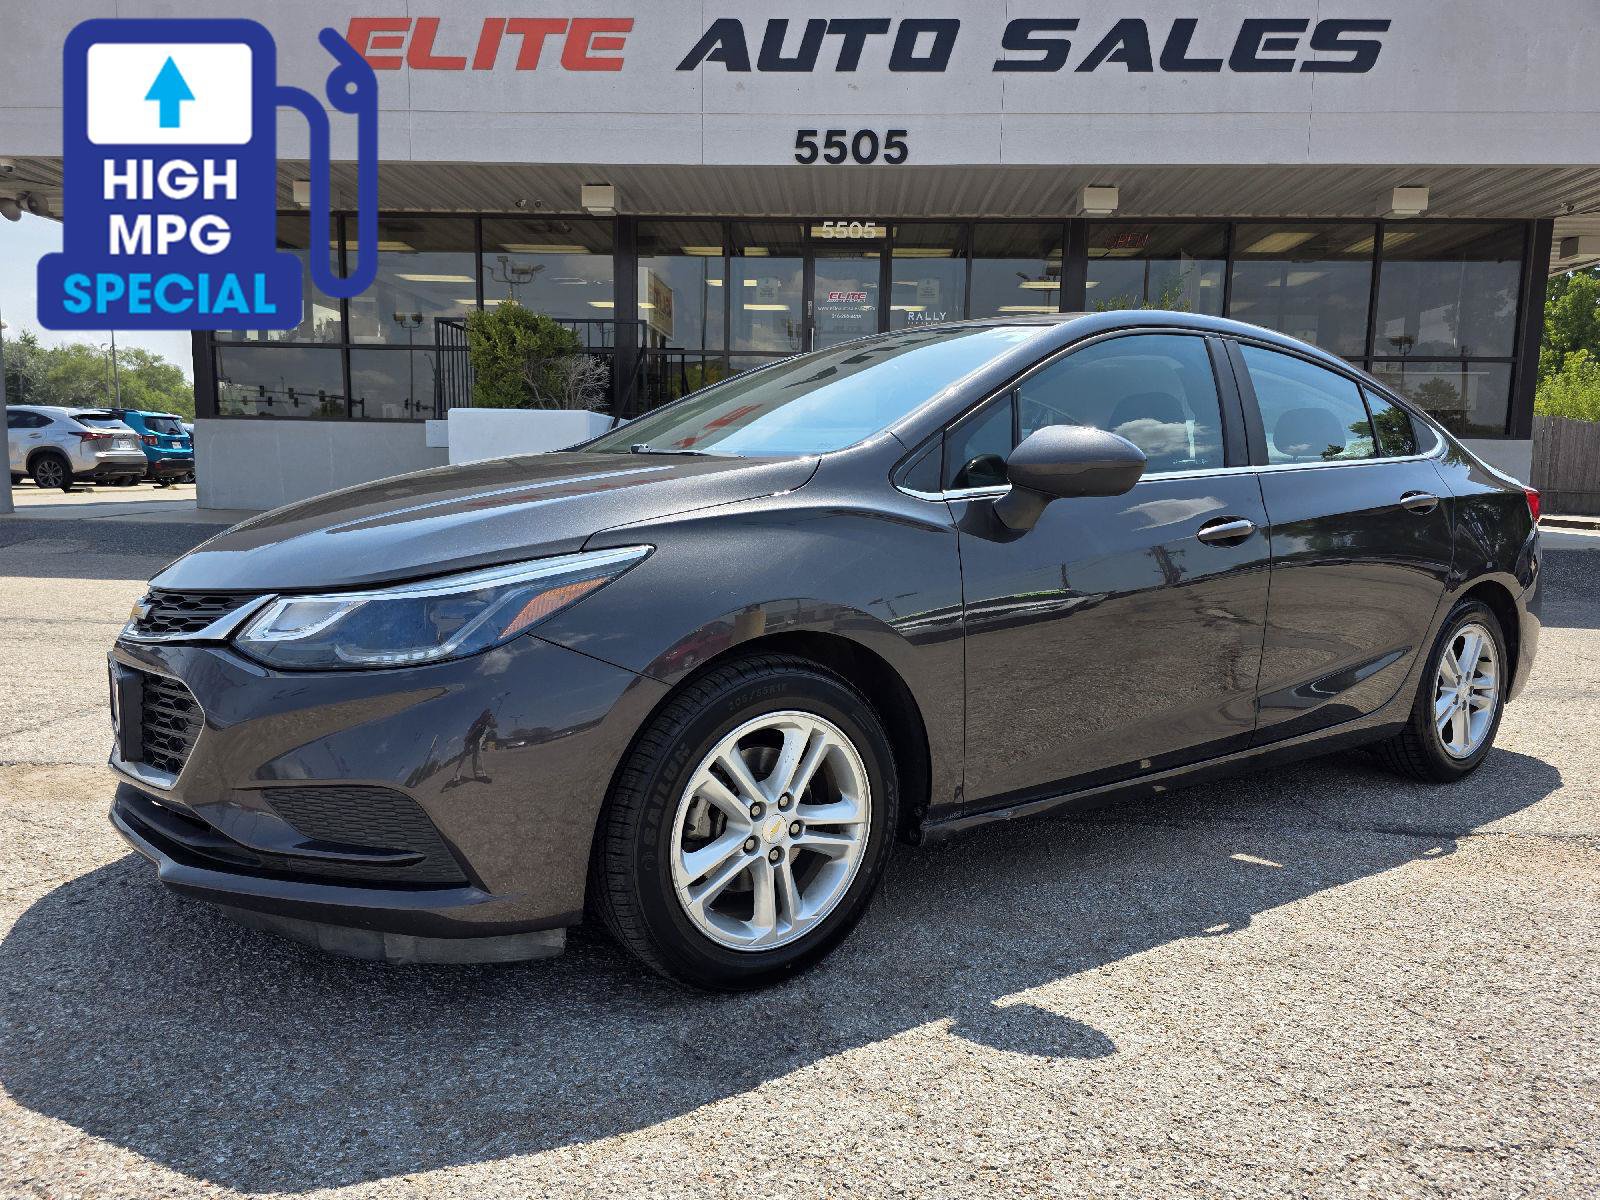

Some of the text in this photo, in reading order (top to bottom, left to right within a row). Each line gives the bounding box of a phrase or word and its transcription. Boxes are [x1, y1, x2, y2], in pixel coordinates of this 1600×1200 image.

[346, 18, 1392, 73] ELITE AUTO SALES
[794, 129, 908, 165] 5505
[821, 221, 876, 239] 5505
[829, 291, 868, 301] ELITE
[908, 311, 947, 321] RALLY
